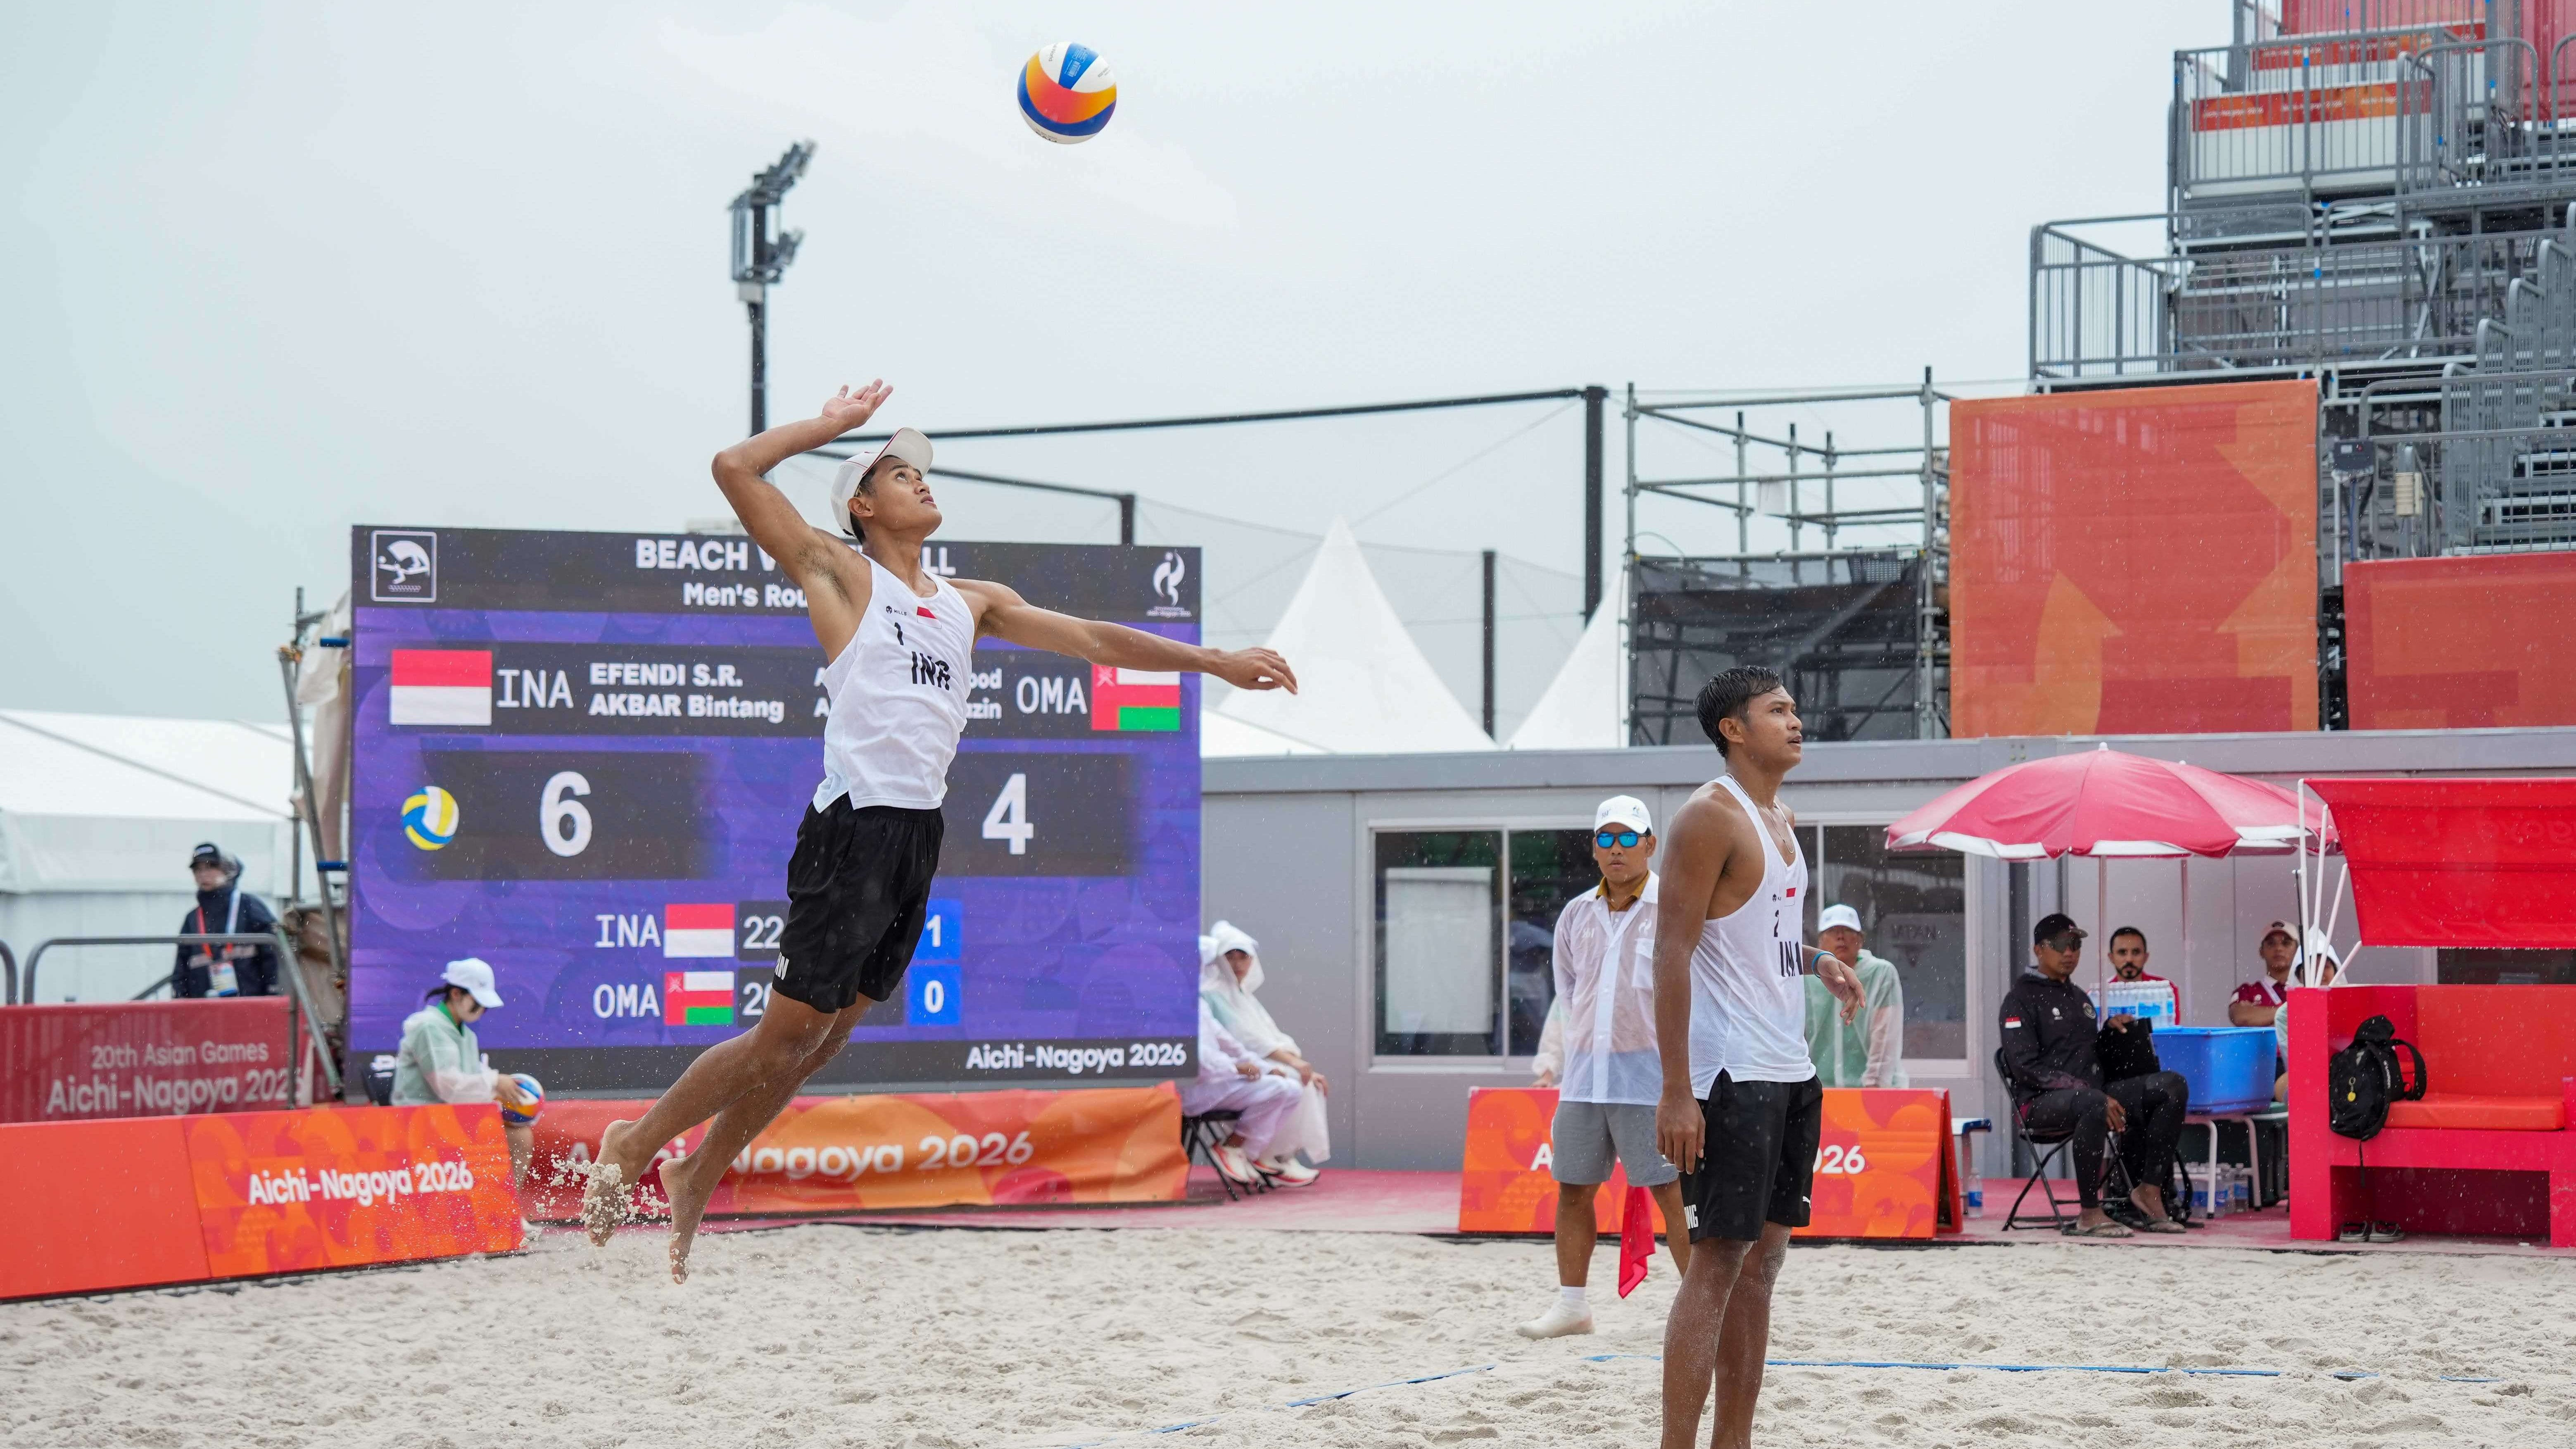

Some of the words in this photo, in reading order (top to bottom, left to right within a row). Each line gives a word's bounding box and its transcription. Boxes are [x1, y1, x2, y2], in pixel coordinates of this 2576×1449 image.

[636, 539, 748, 571] BEACH
[683, 583, 758, 607] Men's
[765, 584, 808, 608] Rou
[894, 622, 904, 645] 1
[589, 663, 685, 686] EFENDI
[694, 664, 743, 688] S.R.
[912, 651, 951, 690] INA
[970, 667, 1002, 689] ood
[496, 669, 574, 709] INA
[1016, 676, 1088, 715] OMA
[589, 694, 682, 717] AKBAR
[687, 695, 784, 723] Bintang
[966, 697, 1002, 719] azin
[539, 771, 593, 857] 6
[982, 773, 1034, 854] 4
[595, 914, 661, 948] INA
[743, 915, 784, 949] 22
[926, 914, 942, 947] 1
[593, 984, 661, 1018] OMA
[924, 980, 944, 1014] 0
[91, 1043, 138, 1069] 20th
[144, 1040, 197, 1067] Asian
[201, 1040, 269, 1064] Games
[966, 1044, 1124, 1073] Aichi-Nagoya
[1129, 1043, 1186, 1066] 2026
[47, 1073, 238, 1115] Aichi-Nagoya
[918, 1130, 1034, 1171] 2026
[1813, 1144, 1865, 1175] 26
[248, 1166, 413, 1207] Aichi-Nagoya
[415, 1160, 475, 1194] 2026
